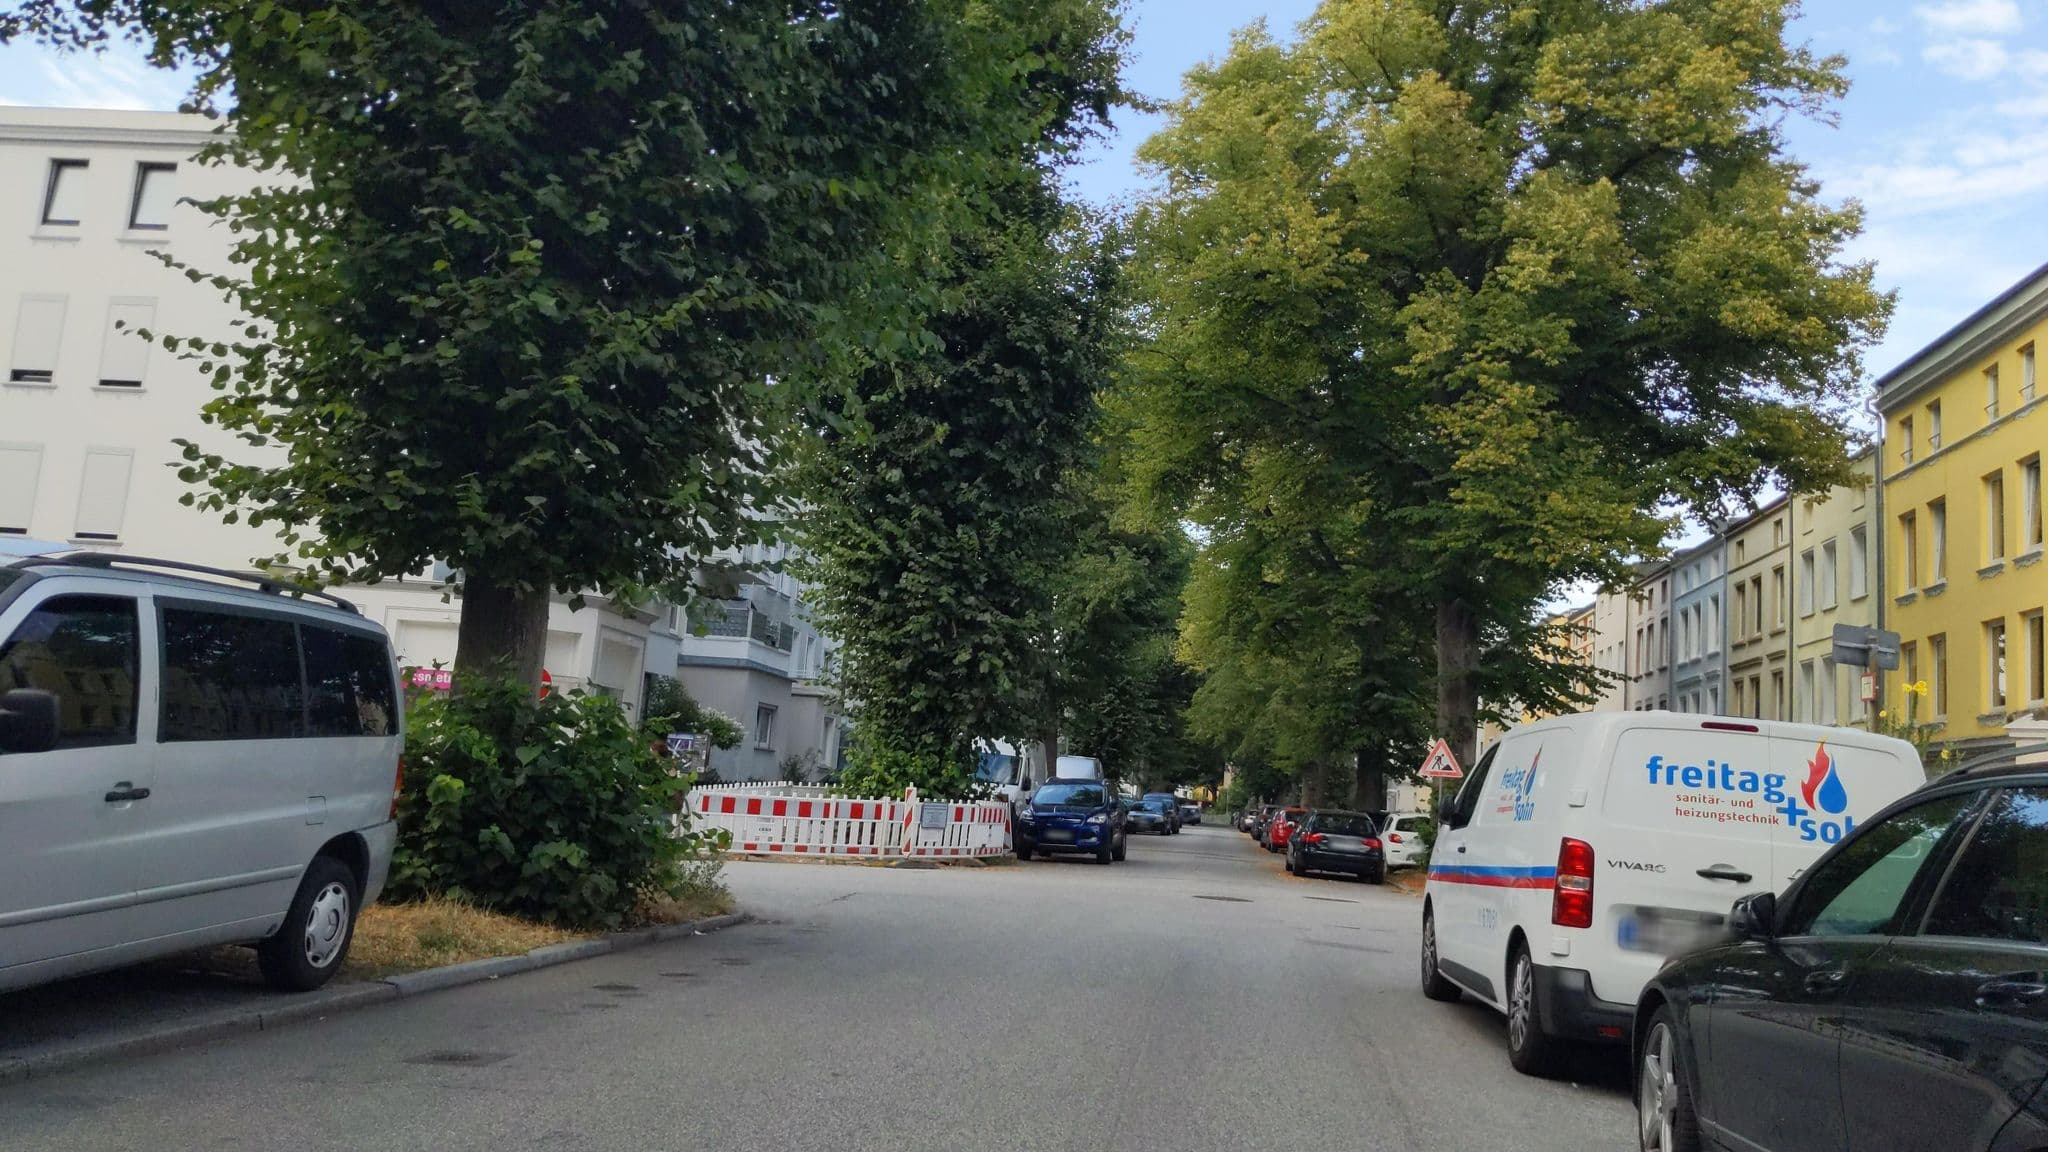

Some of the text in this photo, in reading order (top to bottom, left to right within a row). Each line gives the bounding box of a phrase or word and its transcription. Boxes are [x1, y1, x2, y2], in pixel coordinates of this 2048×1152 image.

[1646, 755, 1787, 804] freitag
[1675, 793, 1754, 809] sanitär- und
[1675, 806, 1780, 825] heizungstechnik
